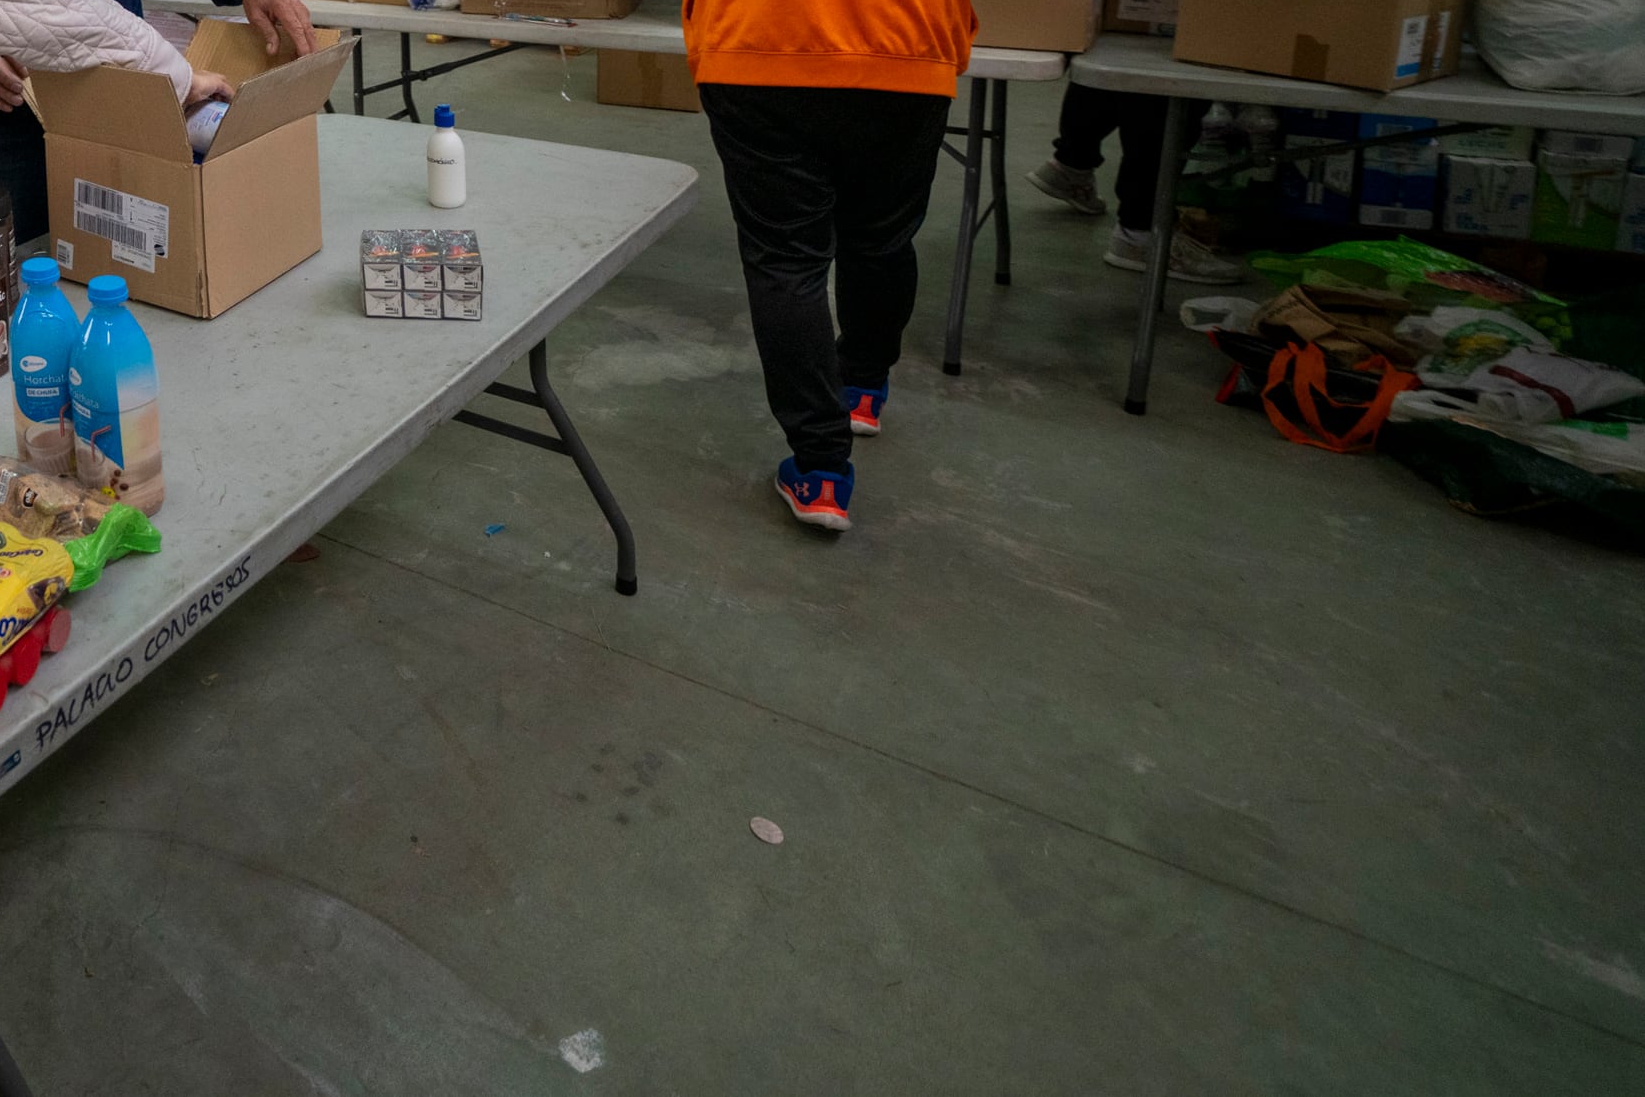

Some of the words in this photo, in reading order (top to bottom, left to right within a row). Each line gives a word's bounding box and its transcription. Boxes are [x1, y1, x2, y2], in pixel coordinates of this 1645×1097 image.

[23, 374, 65, 385] Horchat
[34, 657, 134, 751] PALACIO
[143, 556, 252, 662] CONGRESOS
